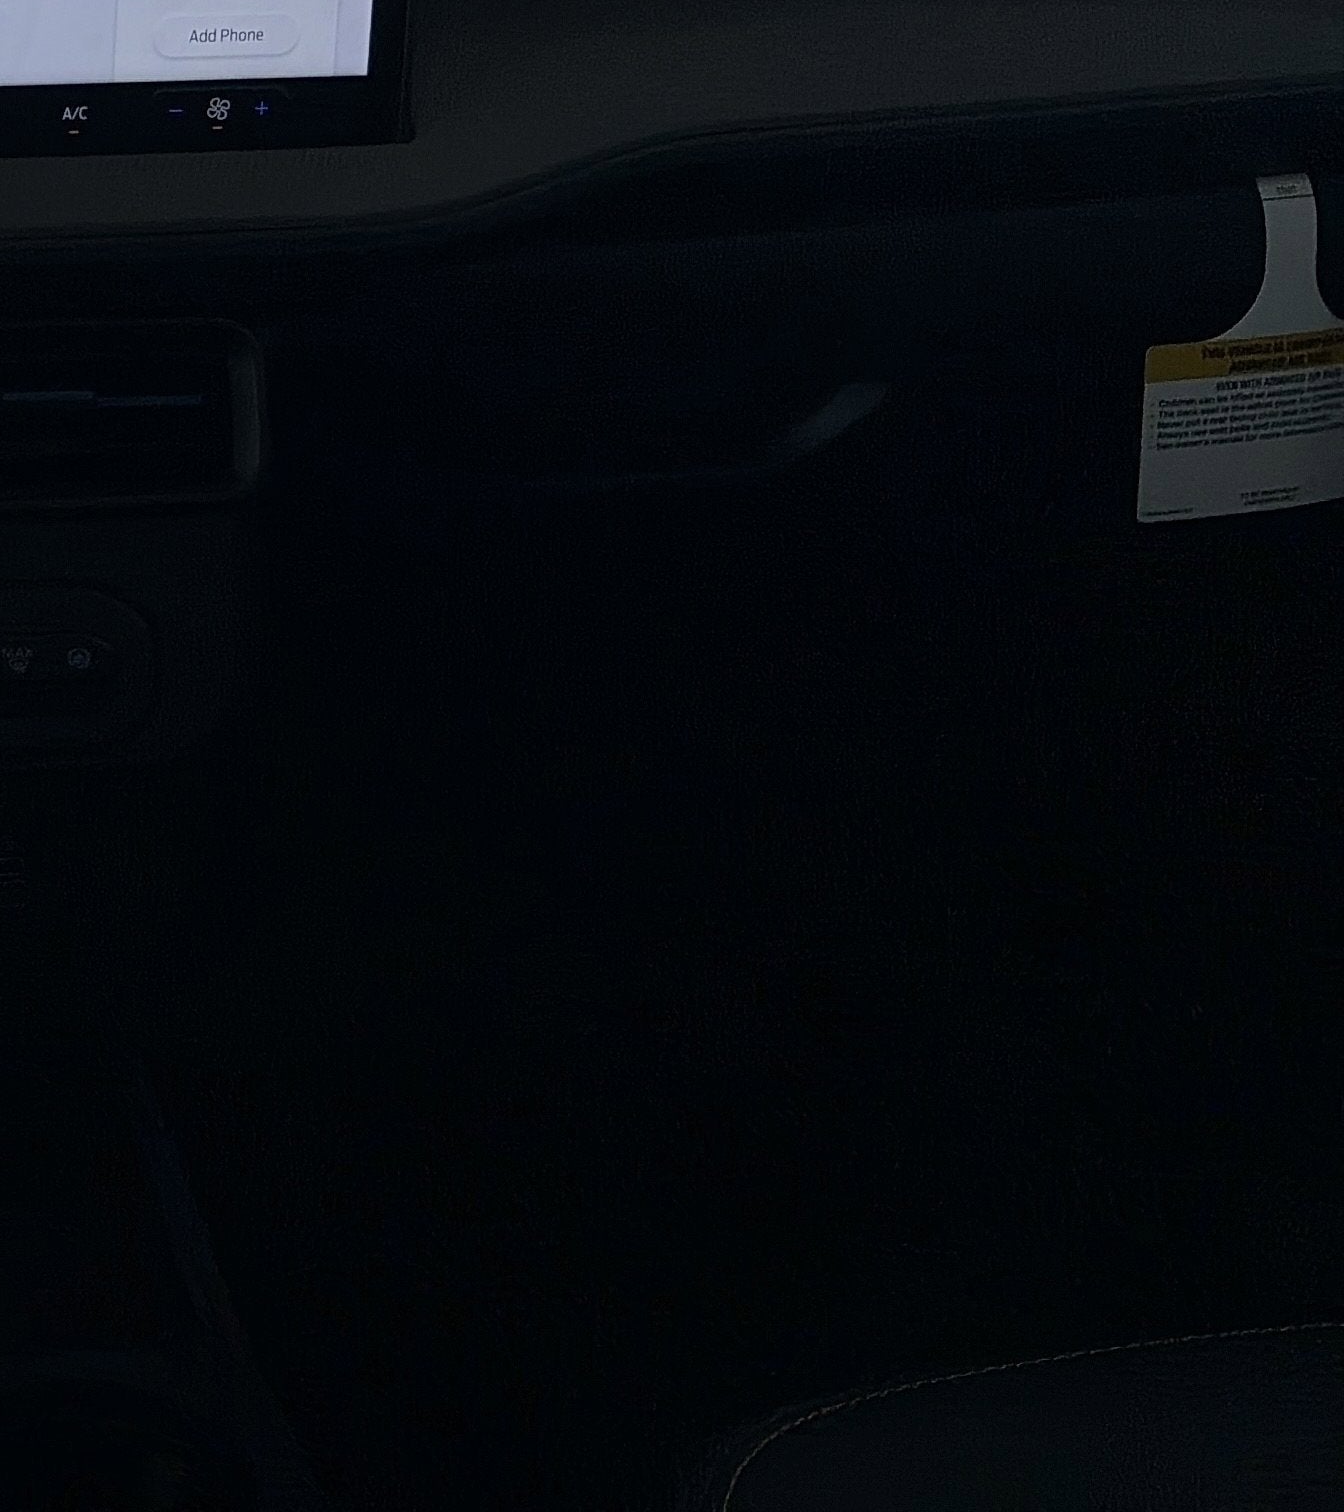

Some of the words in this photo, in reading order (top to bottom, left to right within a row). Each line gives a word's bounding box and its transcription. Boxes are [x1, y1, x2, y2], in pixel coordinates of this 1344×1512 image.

[188, 28, 217, 43] Add
[220, 27, 265, 42] Phone
[61, 105, 89, 121] A/C
